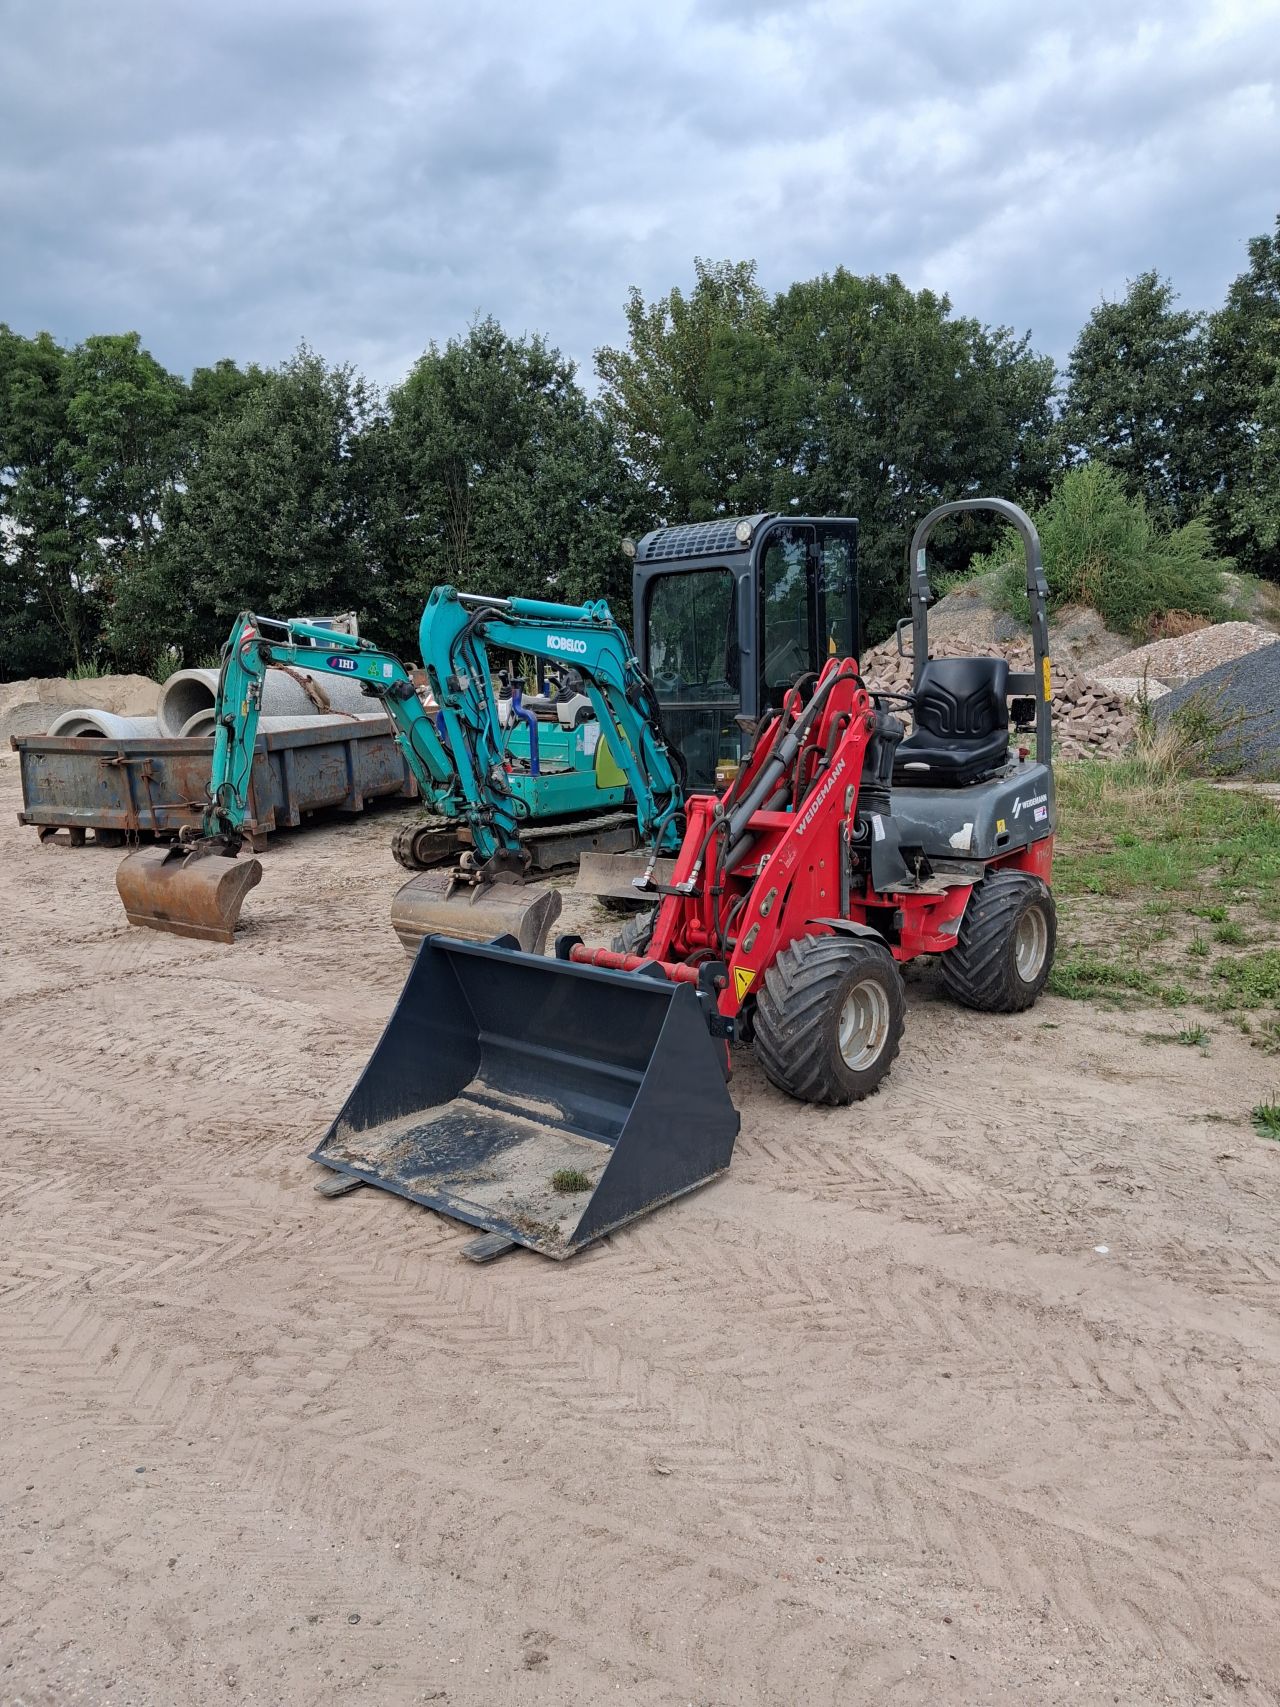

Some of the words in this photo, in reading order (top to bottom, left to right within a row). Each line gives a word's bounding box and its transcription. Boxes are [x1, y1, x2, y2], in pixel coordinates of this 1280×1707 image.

[547, 635, 587, 653] KOBELCO
[338, 658, 354, 670] IHI
[796, 758, 846, 835] WEIDEMANN
[1022, 794, 1048, 809] WEIDEMANN
